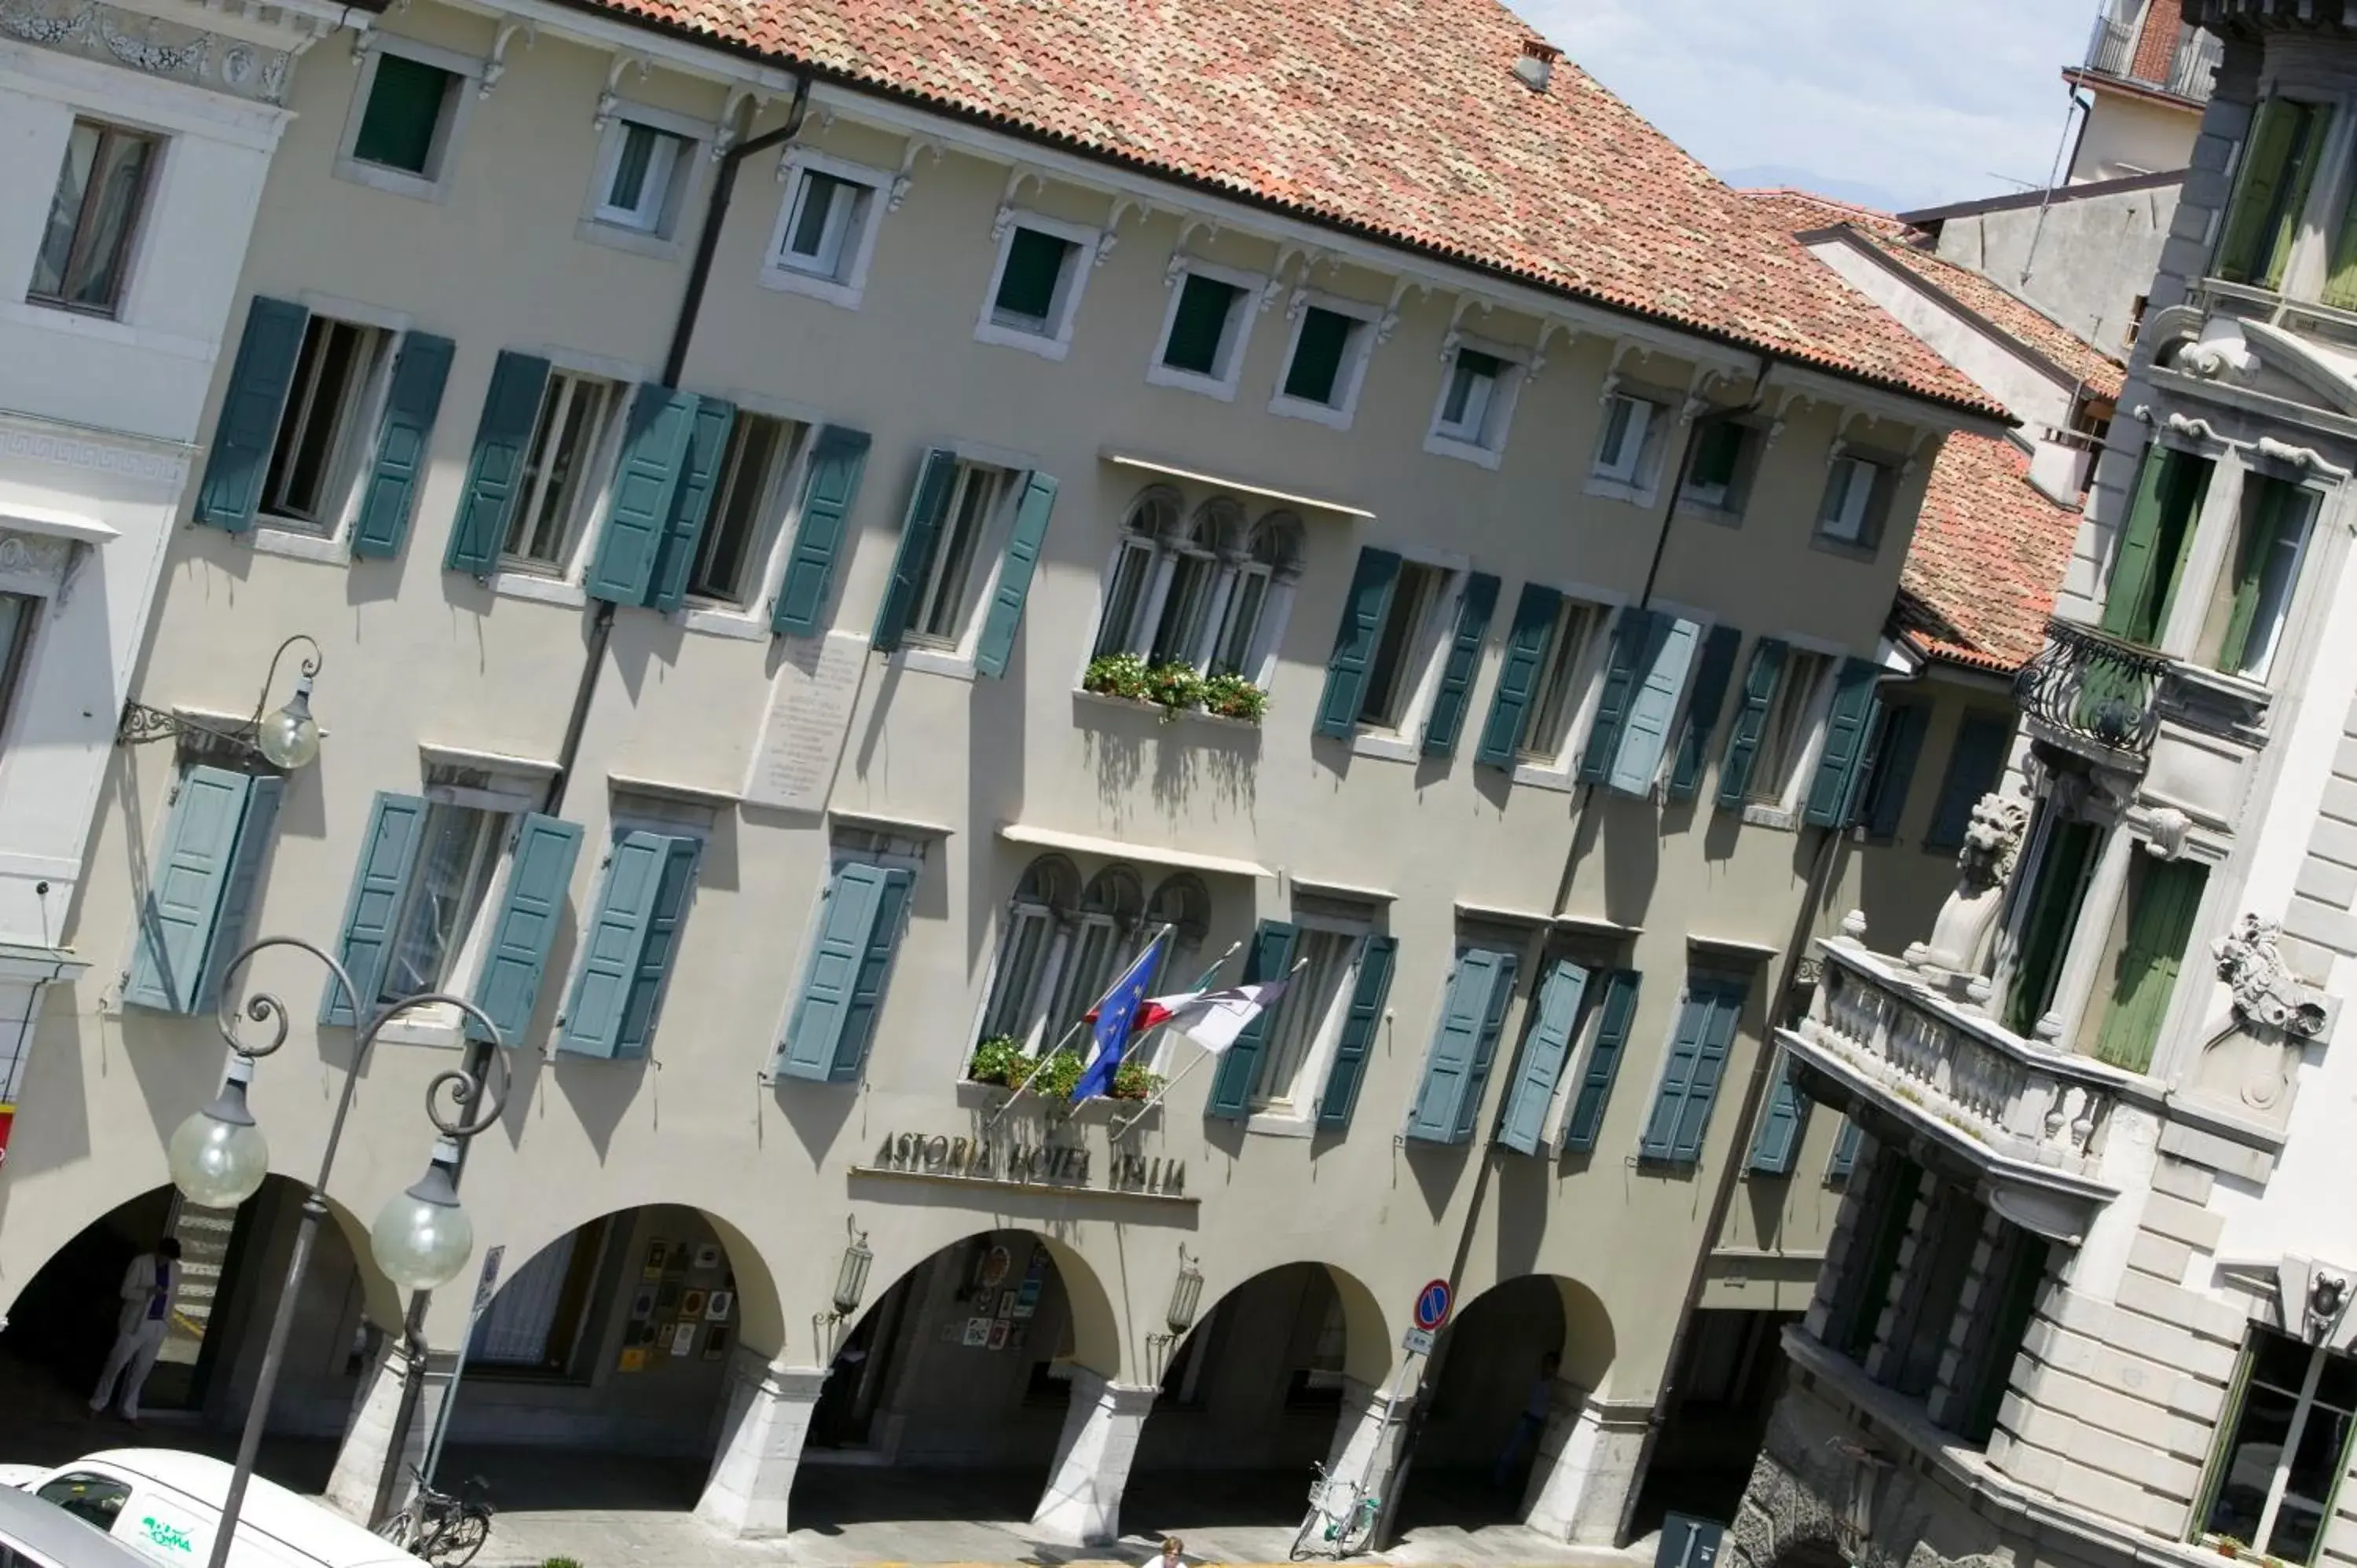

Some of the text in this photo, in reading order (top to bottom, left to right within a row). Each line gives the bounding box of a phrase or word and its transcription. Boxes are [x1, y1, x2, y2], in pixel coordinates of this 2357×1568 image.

[874, 1130, 1185, 1196] ASTORIA HOTEL ITALIA
